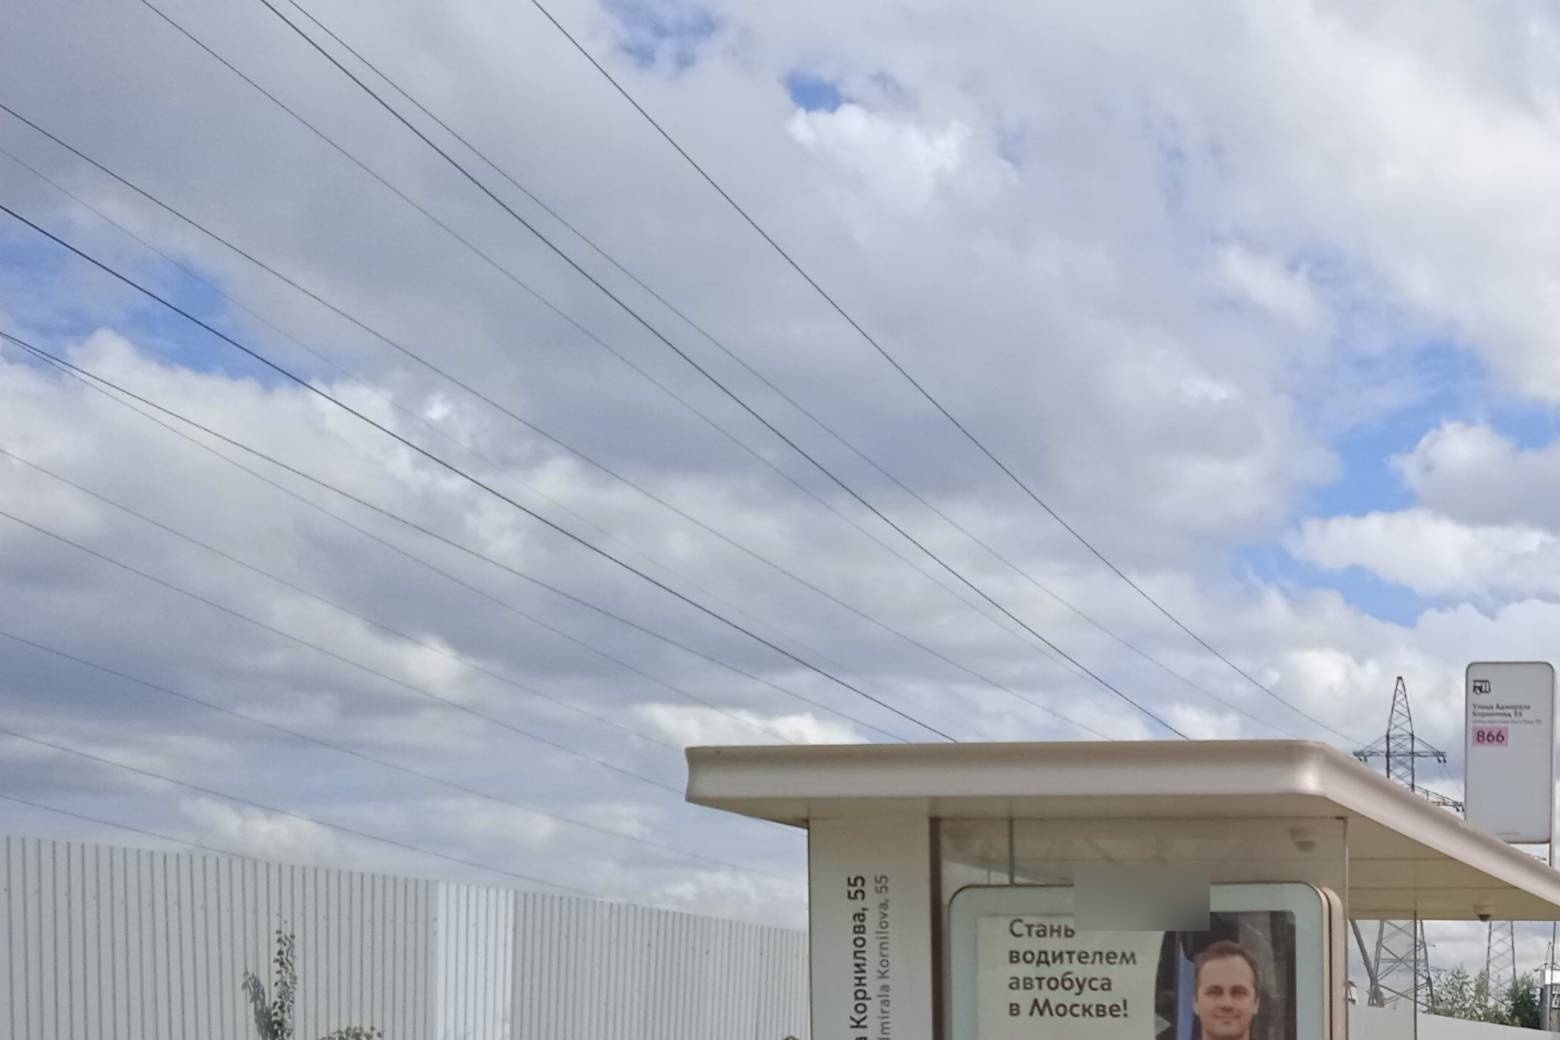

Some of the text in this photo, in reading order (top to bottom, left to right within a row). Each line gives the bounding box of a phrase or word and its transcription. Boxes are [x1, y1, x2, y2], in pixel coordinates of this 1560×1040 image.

[1476, 730, 1505, 743] 866
[848, 875, 866, 900] 55
[874, 875, 889, 896] 55
[1009, 918, 1076, 938] Стань
[875, 899, 892, 979] Kornilova,
[850, 905, 873, 1029] Корнилова,
[1008, 949, 1137, 967] водителем
[1008, 972, 1113, 995] автобуса
[1009, 998, 1128, 1018] в Москве!
